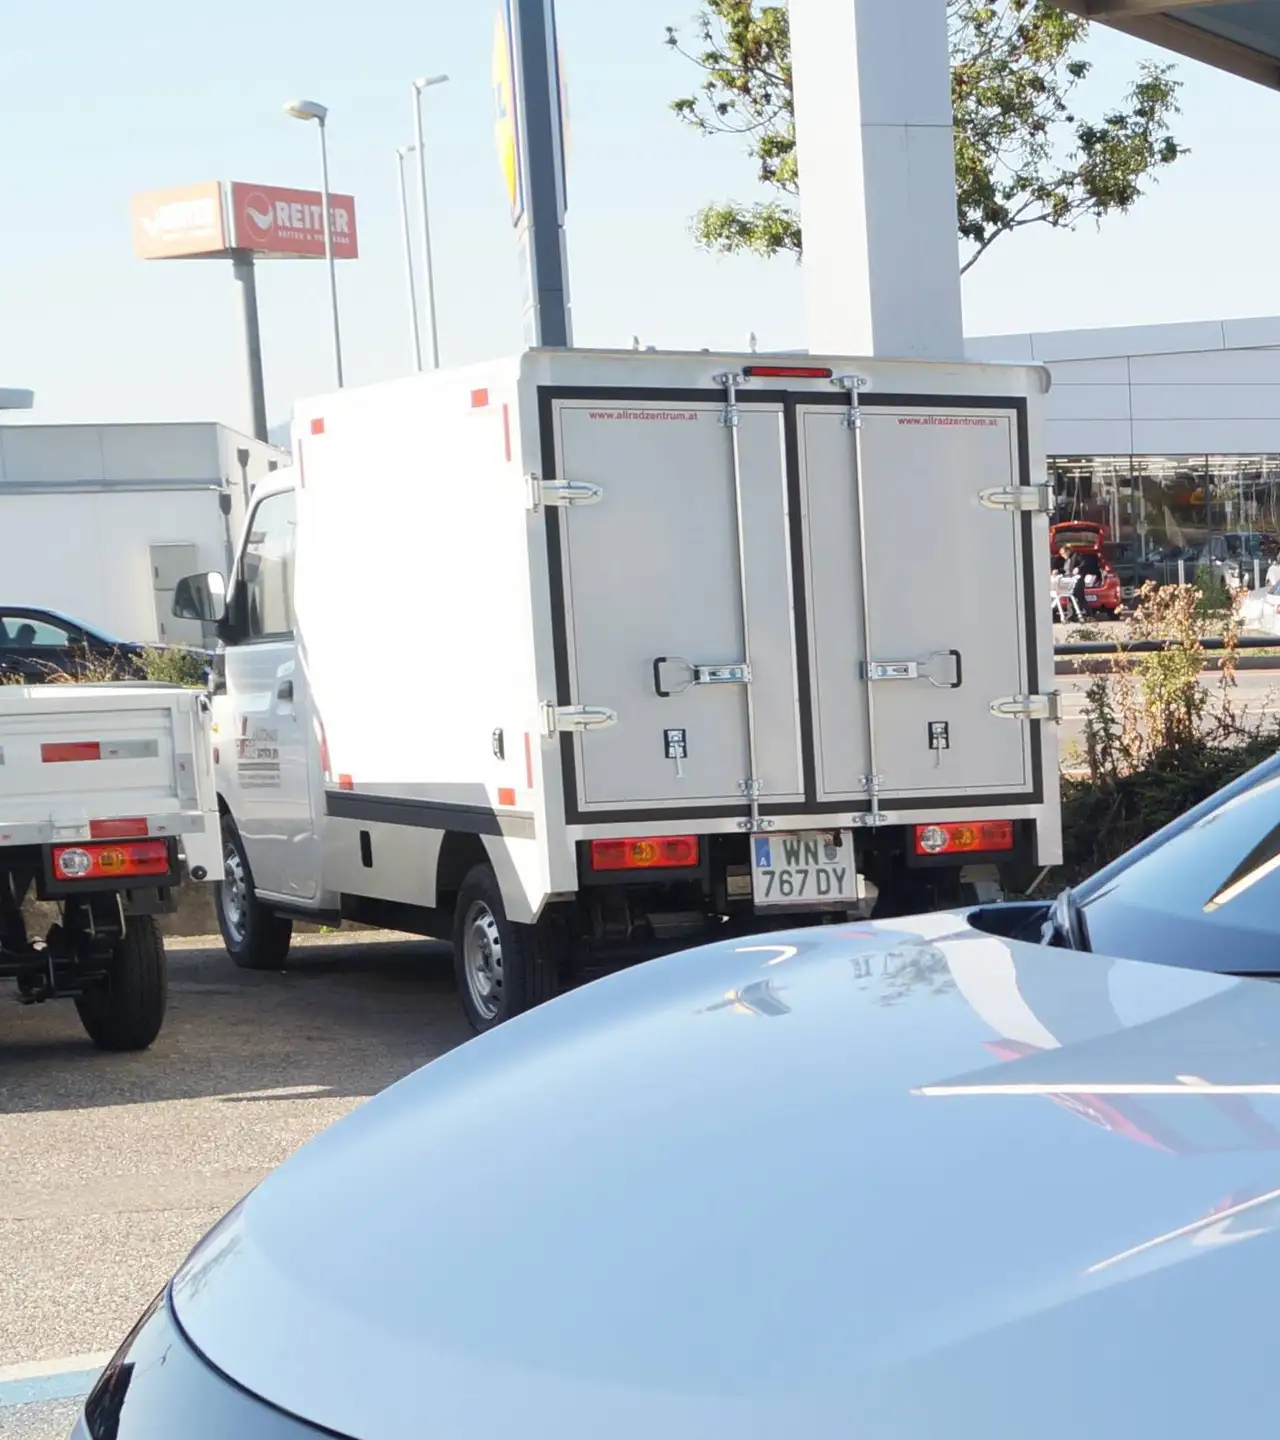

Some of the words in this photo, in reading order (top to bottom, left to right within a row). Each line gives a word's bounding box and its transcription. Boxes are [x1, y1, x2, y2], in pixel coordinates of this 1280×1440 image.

[589, 410, 698, 421] www.allradzentrum.at
[782, 839, 819, 867] WN
[761, 869, 809, 898] 767
[815, 867, 846, 895] DY
